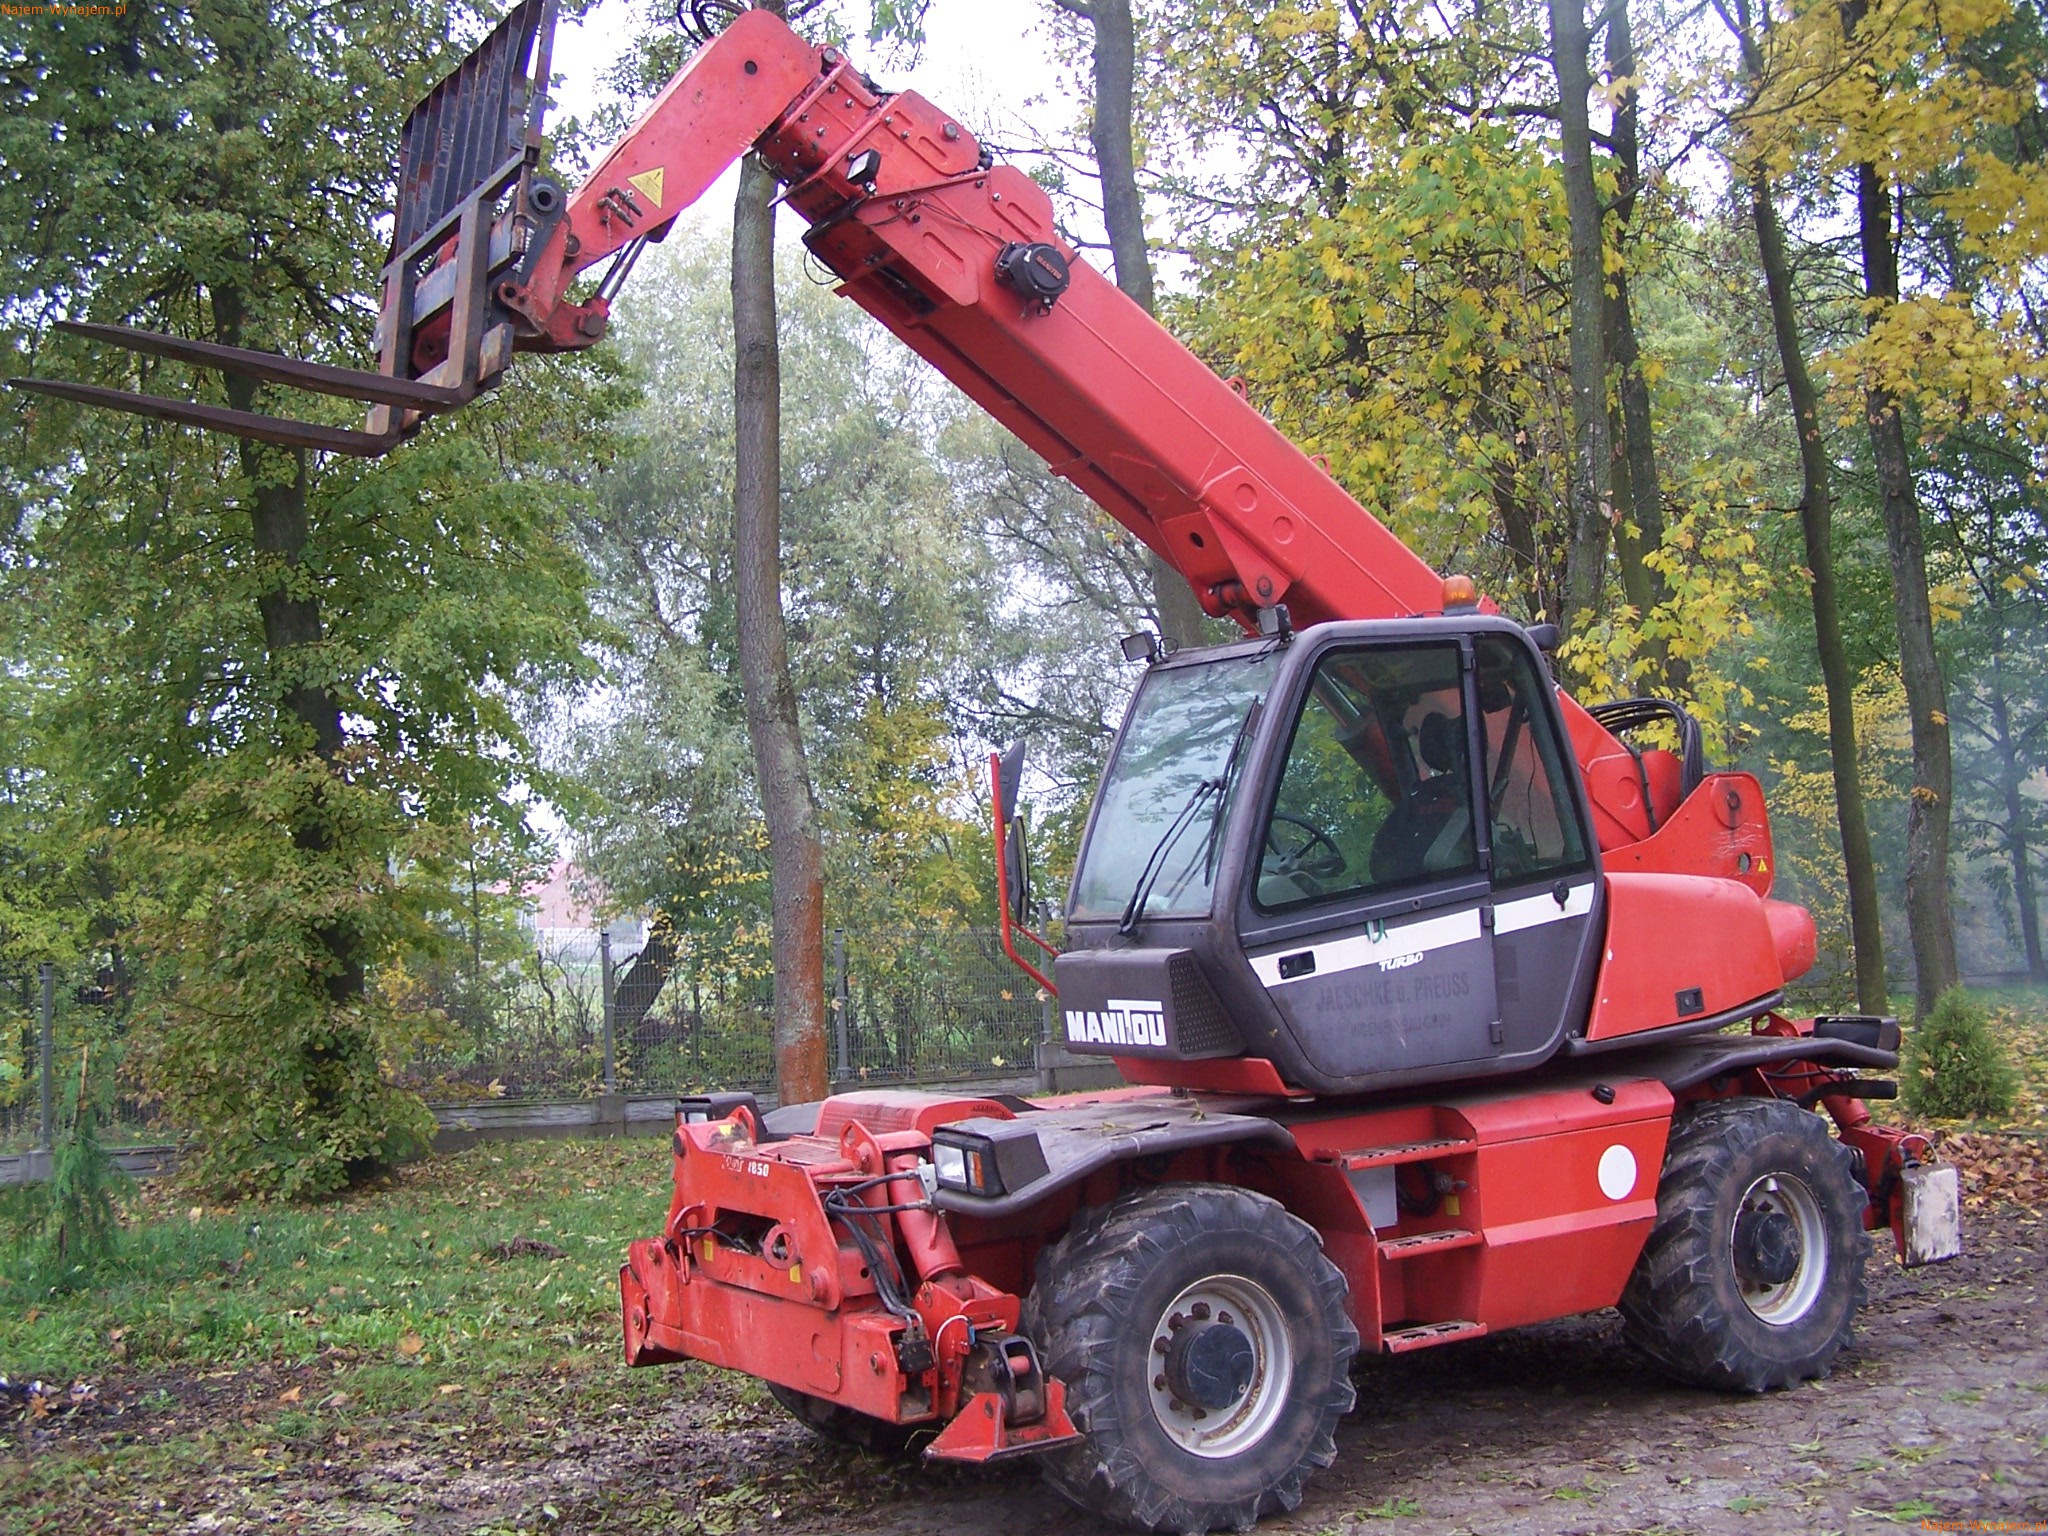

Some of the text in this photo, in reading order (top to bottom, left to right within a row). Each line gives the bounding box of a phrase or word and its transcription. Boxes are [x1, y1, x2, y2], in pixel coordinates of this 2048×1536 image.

[1378, 951, 1424, 972] TURBO
[1414, 972, 1470, 1000] PREUSS
[1065, 999, 1167, 1046] MANITOU
[748, 1161, 769, 1177] 1850
